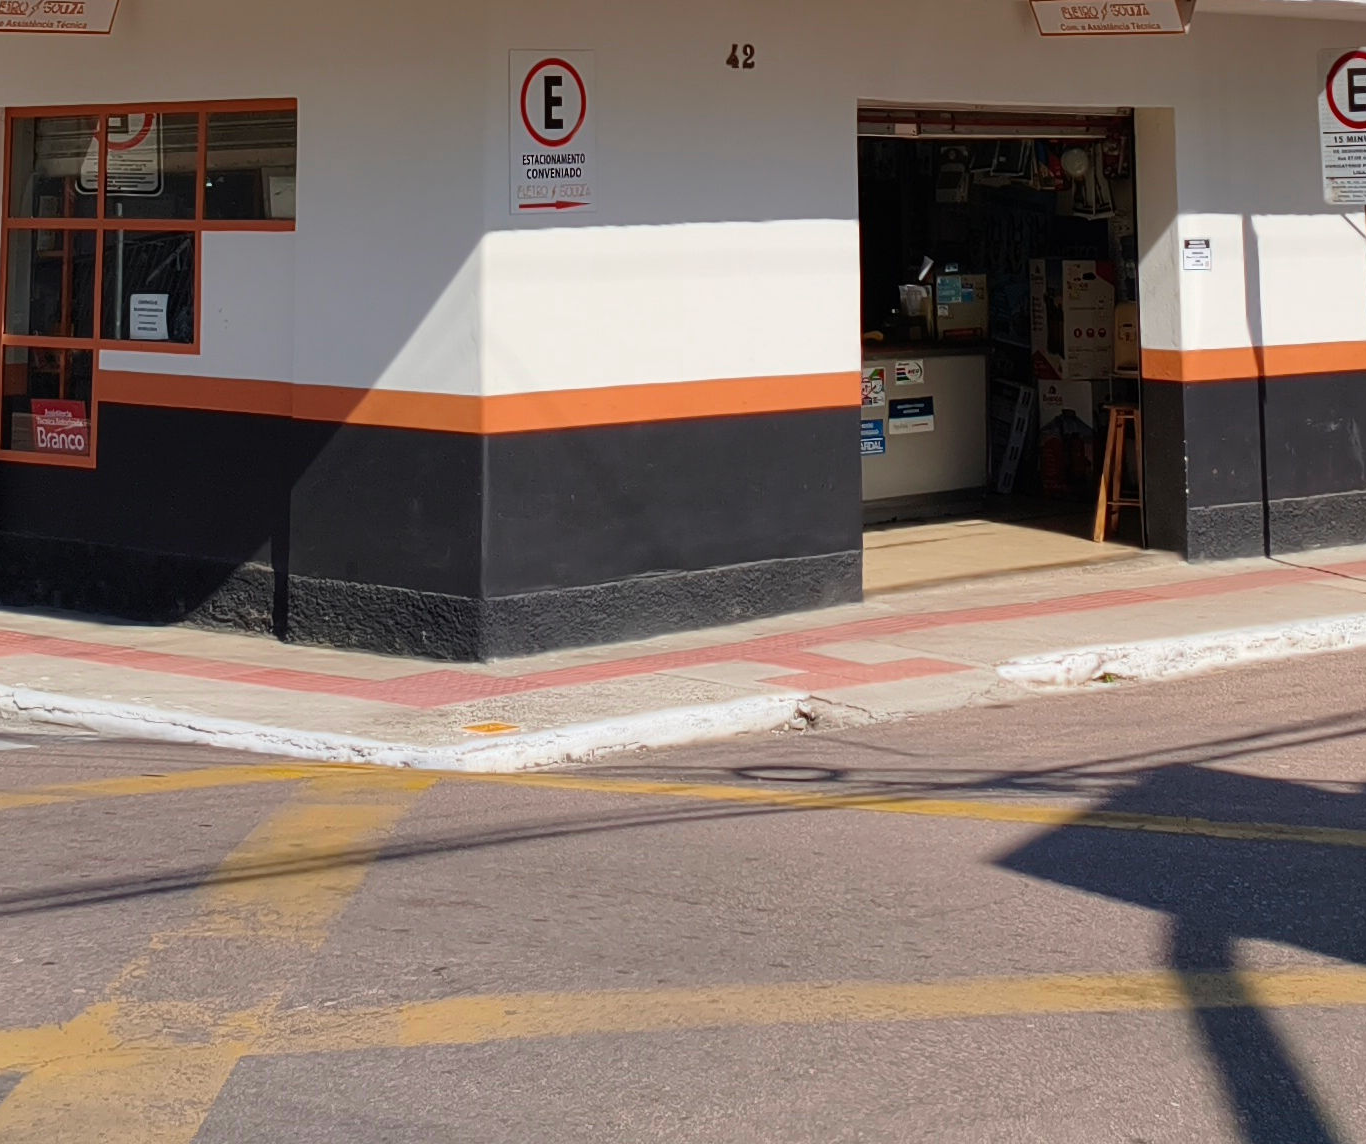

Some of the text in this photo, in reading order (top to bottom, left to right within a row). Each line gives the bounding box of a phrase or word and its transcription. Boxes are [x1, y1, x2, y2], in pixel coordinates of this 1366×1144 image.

[43, 0, 86, 15] SOUZA
[56, 20, 88, 30] Técnica
[725, 43, 756, 69] 42
[544, 75, 564, 130] E
[1333, 135, 1344, 144] 15
[522, 153, 586, 166] ESTACIONAMENTO
[526, 167, 582, 180] CONVENIADO
[36, 426, 85, 451] Branco
